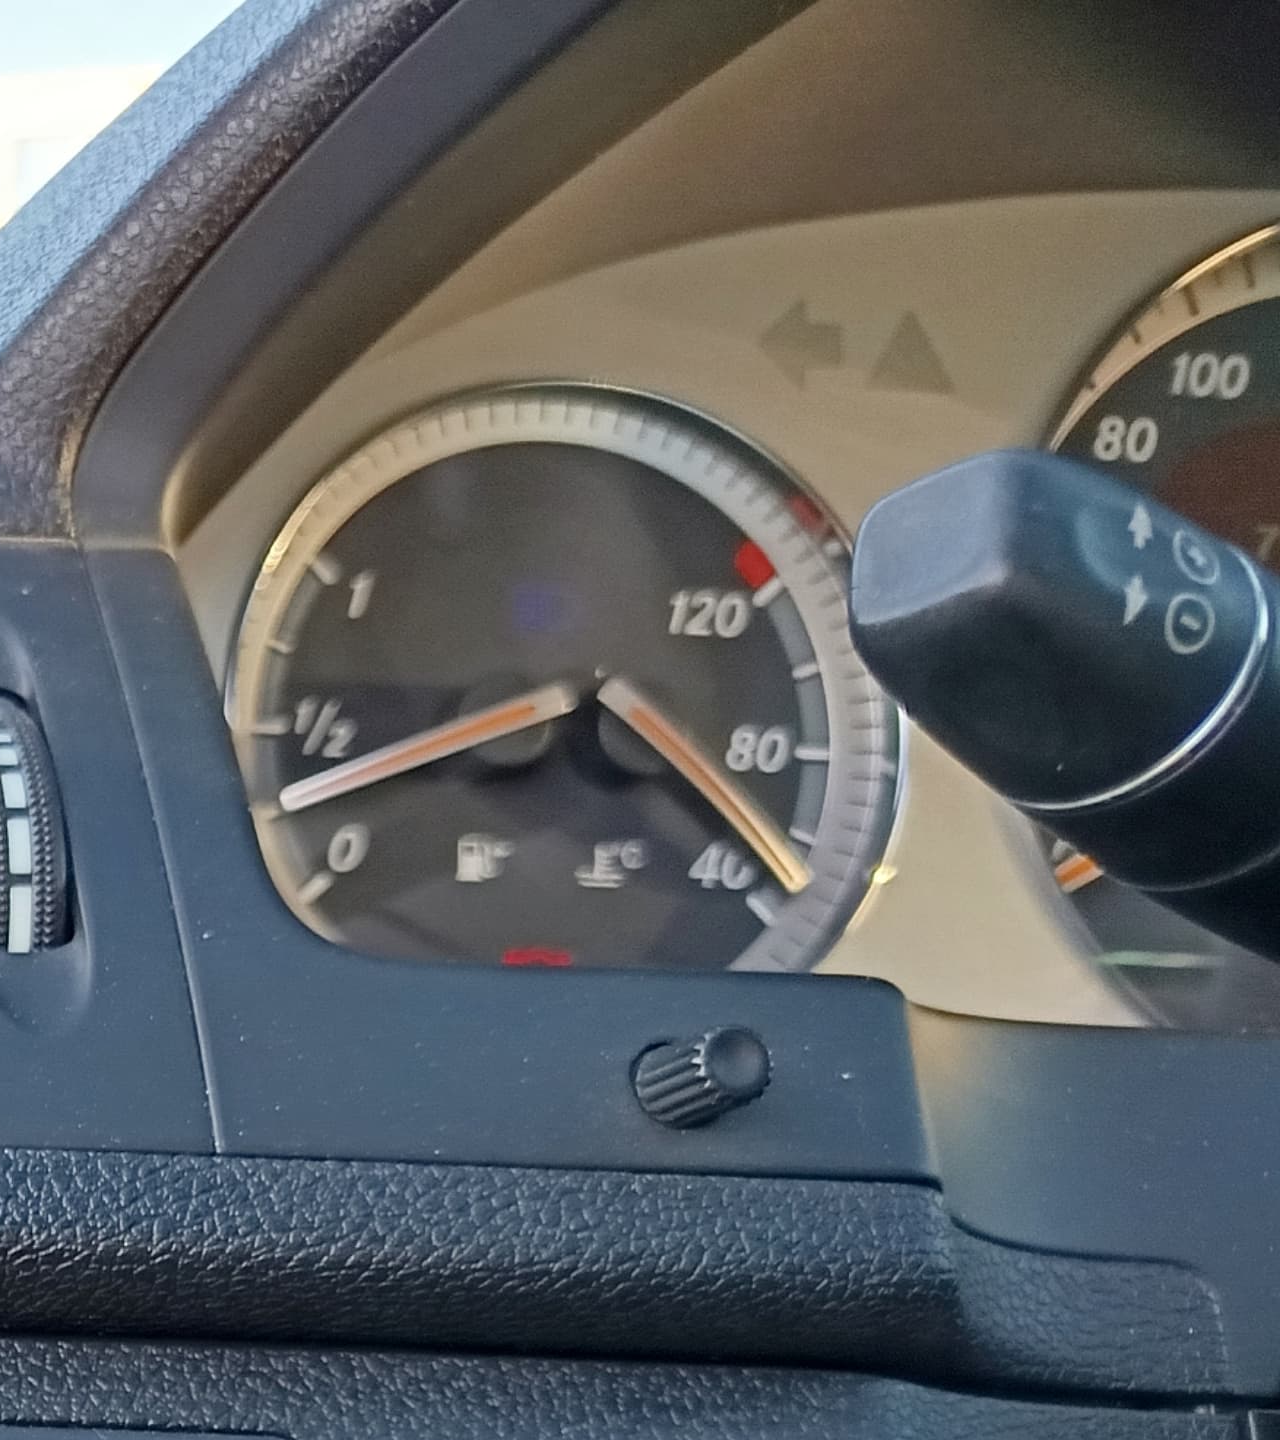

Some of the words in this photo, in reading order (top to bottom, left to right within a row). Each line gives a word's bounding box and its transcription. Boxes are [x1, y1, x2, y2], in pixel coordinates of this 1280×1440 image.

[1170, 351, 1251, 400] 100
[1093, 415, 1159, 463] 80
[348, 571, 374, 619] 1
[667, 590, 746, 638] 120
[725, 726, 790, 774] 80
[327, 823, 370, 873] 0
[688, 843, 758, 890] 40
